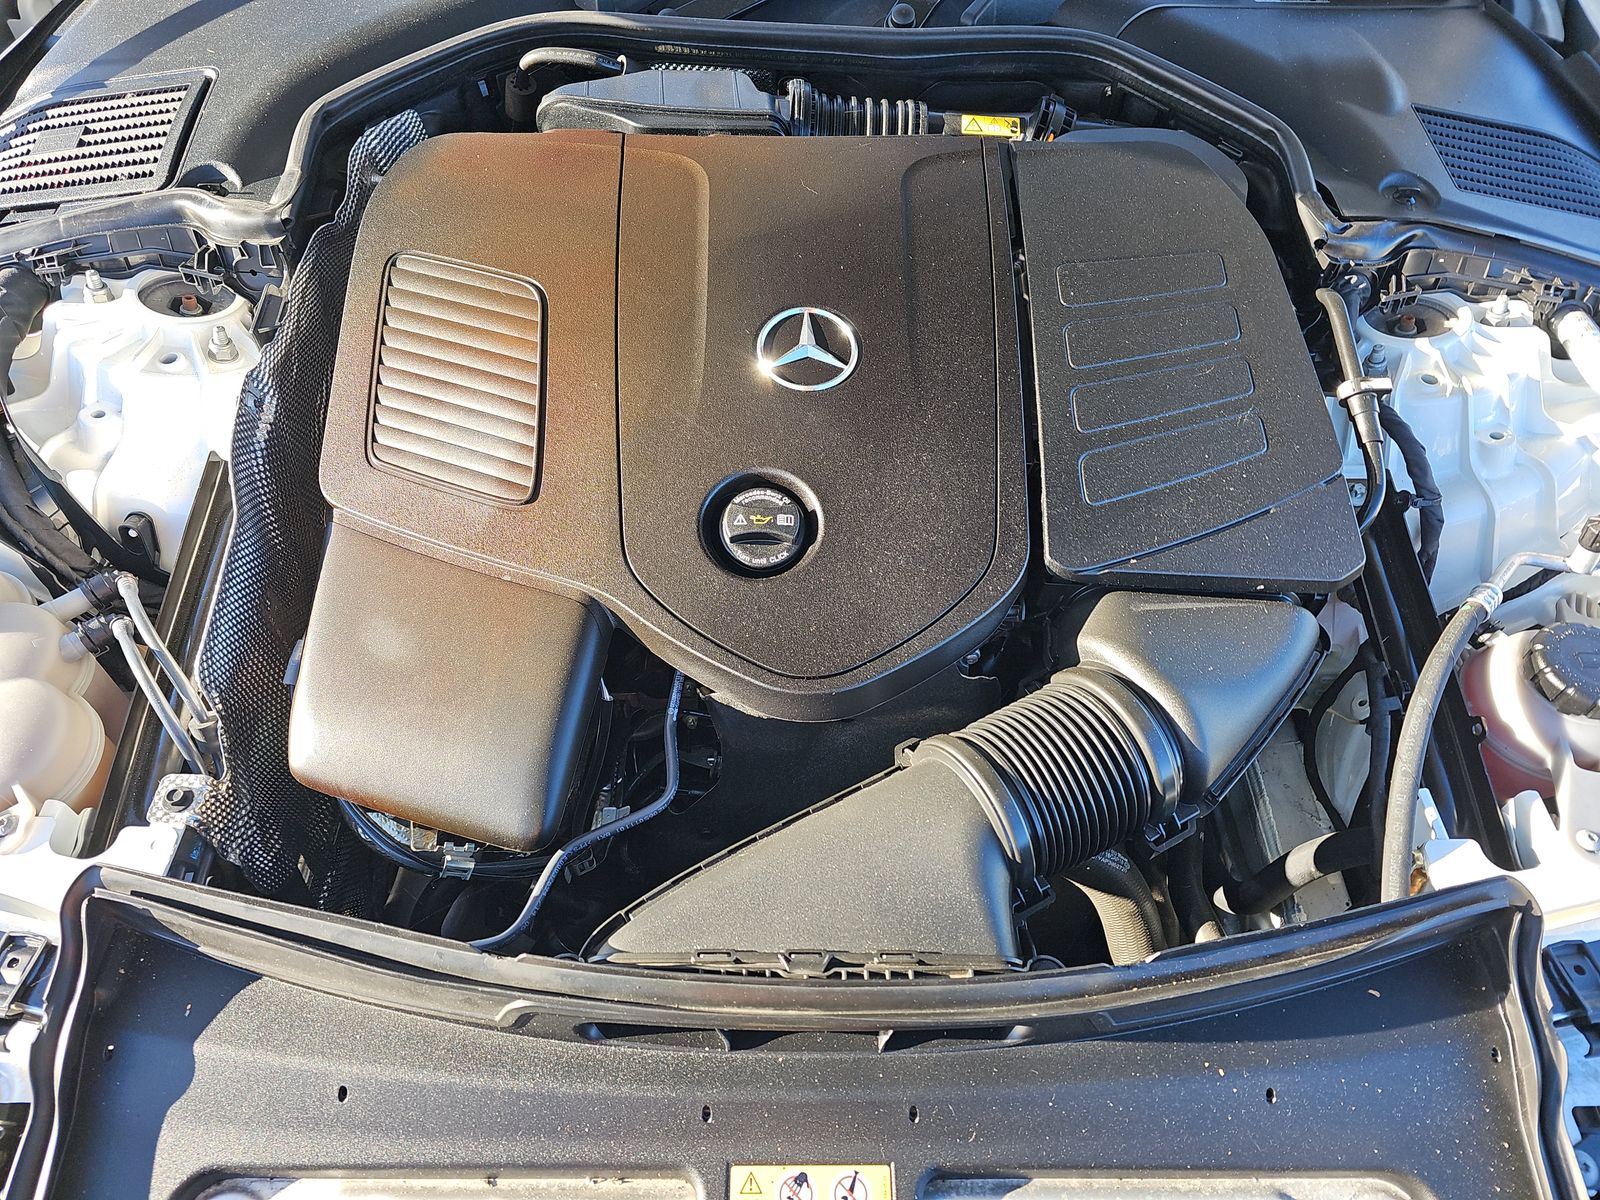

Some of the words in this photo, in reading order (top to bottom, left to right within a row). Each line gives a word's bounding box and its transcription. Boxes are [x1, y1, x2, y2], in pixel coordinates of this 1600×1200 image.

[733, 490, 782, 503] Mercedes-Benz
[741, 495, 784, 506] recommended
[736, 550, 750, 561] Turn
[769, 550, 790, 563] CLICK
